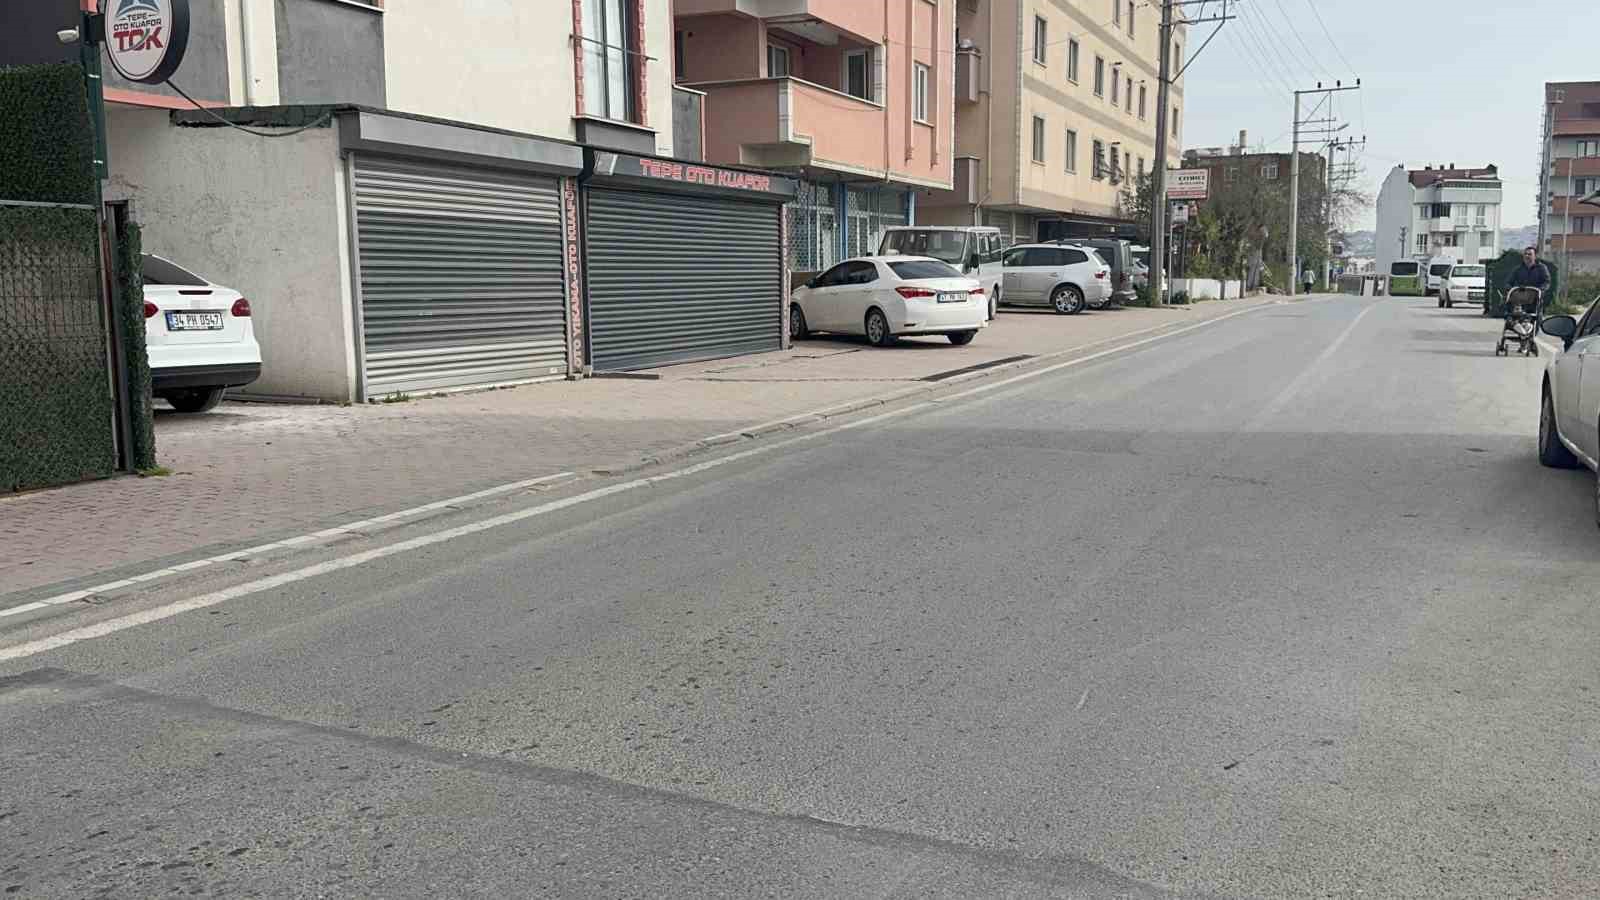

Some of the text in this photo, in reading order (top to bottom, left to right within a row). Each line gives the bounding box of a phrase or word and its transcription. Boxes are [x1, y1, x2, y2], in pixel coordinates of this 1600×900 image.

[128, 13, 148, 21] TEPE
[113, 23, 129, 31] OTO
[113, 26, 163, 50] TDK
[640, 158, 682, 181] TEPE
[687, 166, 715, 185] OTO
[175, 314, 184, 326] 34
[573, 339, 582, 368] OTO
